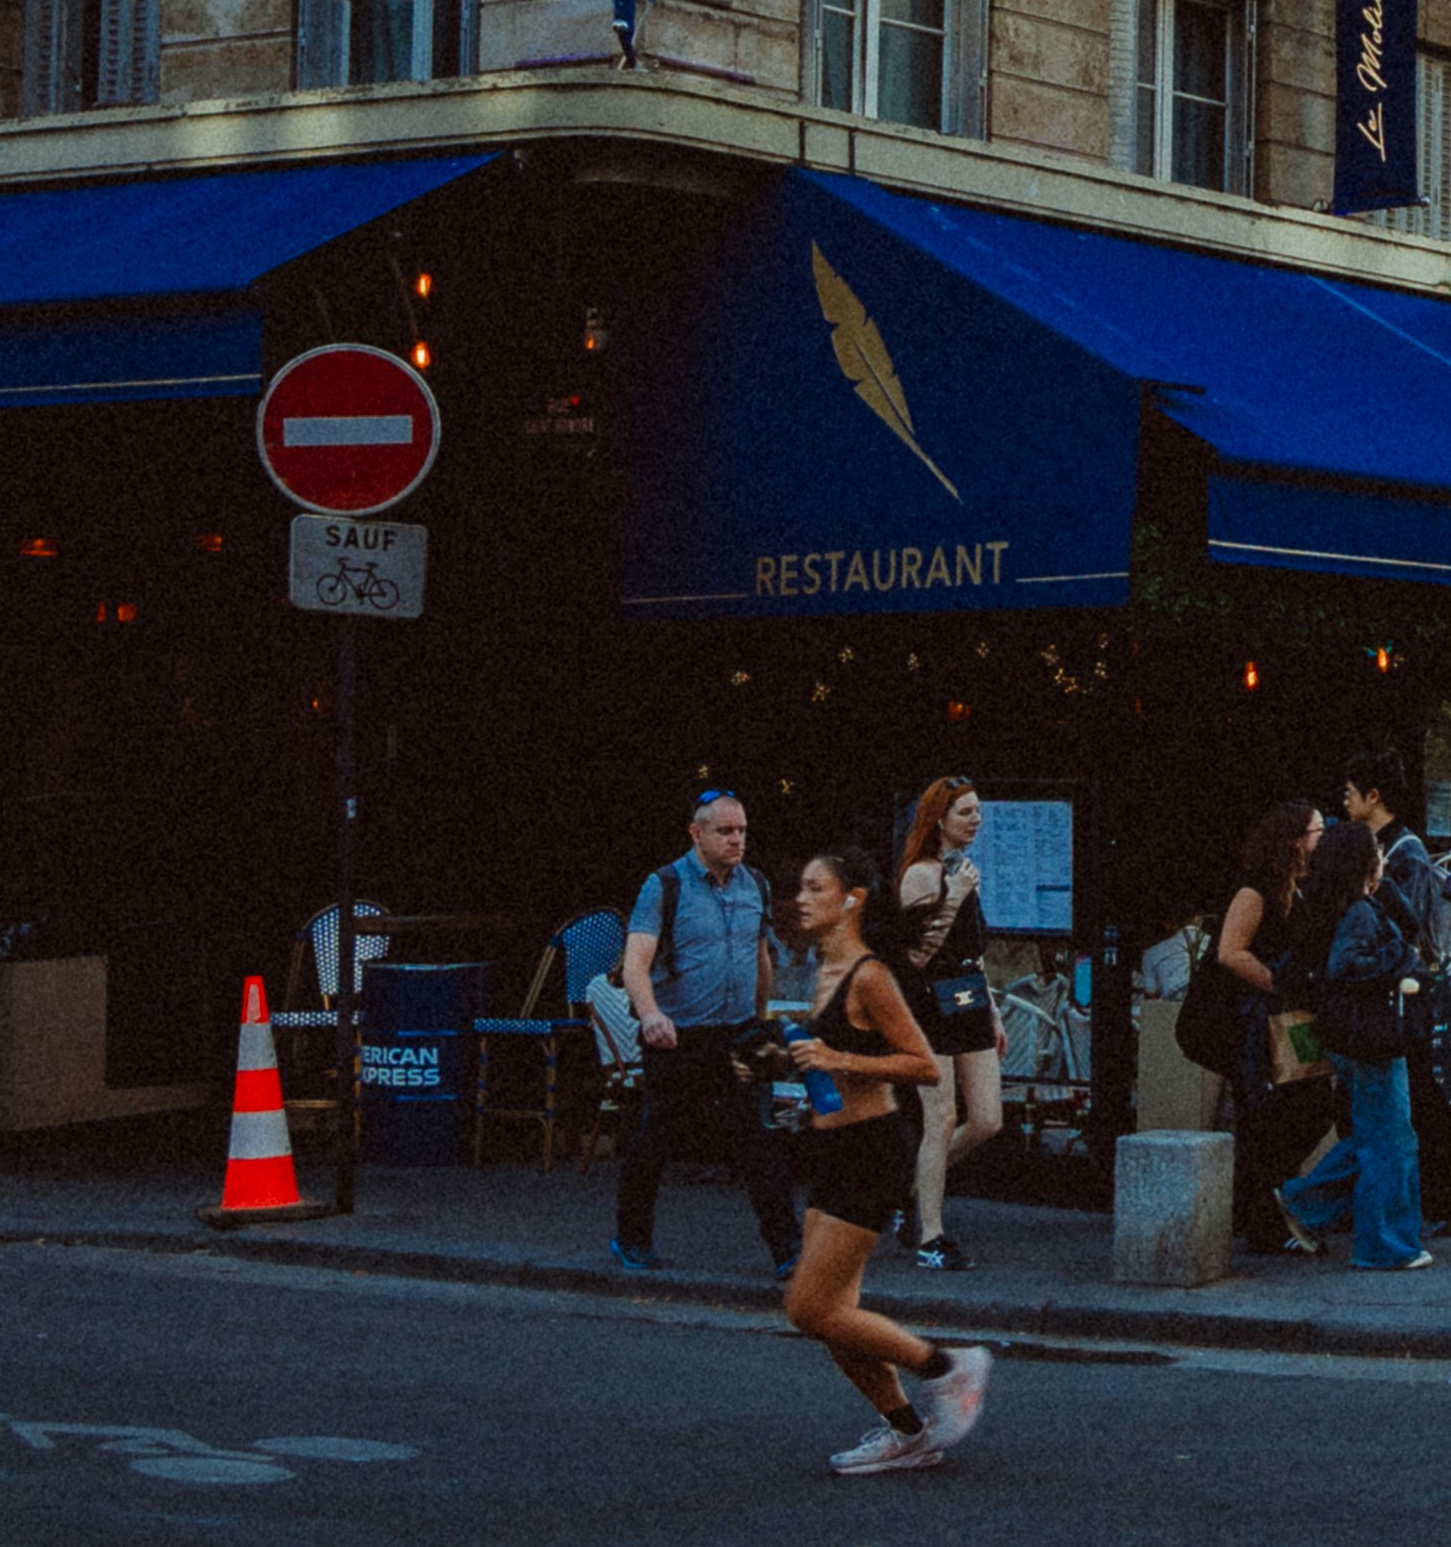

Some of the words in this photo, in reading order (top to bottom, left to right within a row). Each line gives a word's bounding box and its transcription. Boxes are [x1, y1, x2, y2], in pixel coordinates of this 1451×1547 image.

[1357, 104, 1388, 163] Le
[325, 524, 398, 553] SAUF
[755, 541, 1010, 598] RESTAURANT
[361, 1046, 439, 1065] ERICAN
